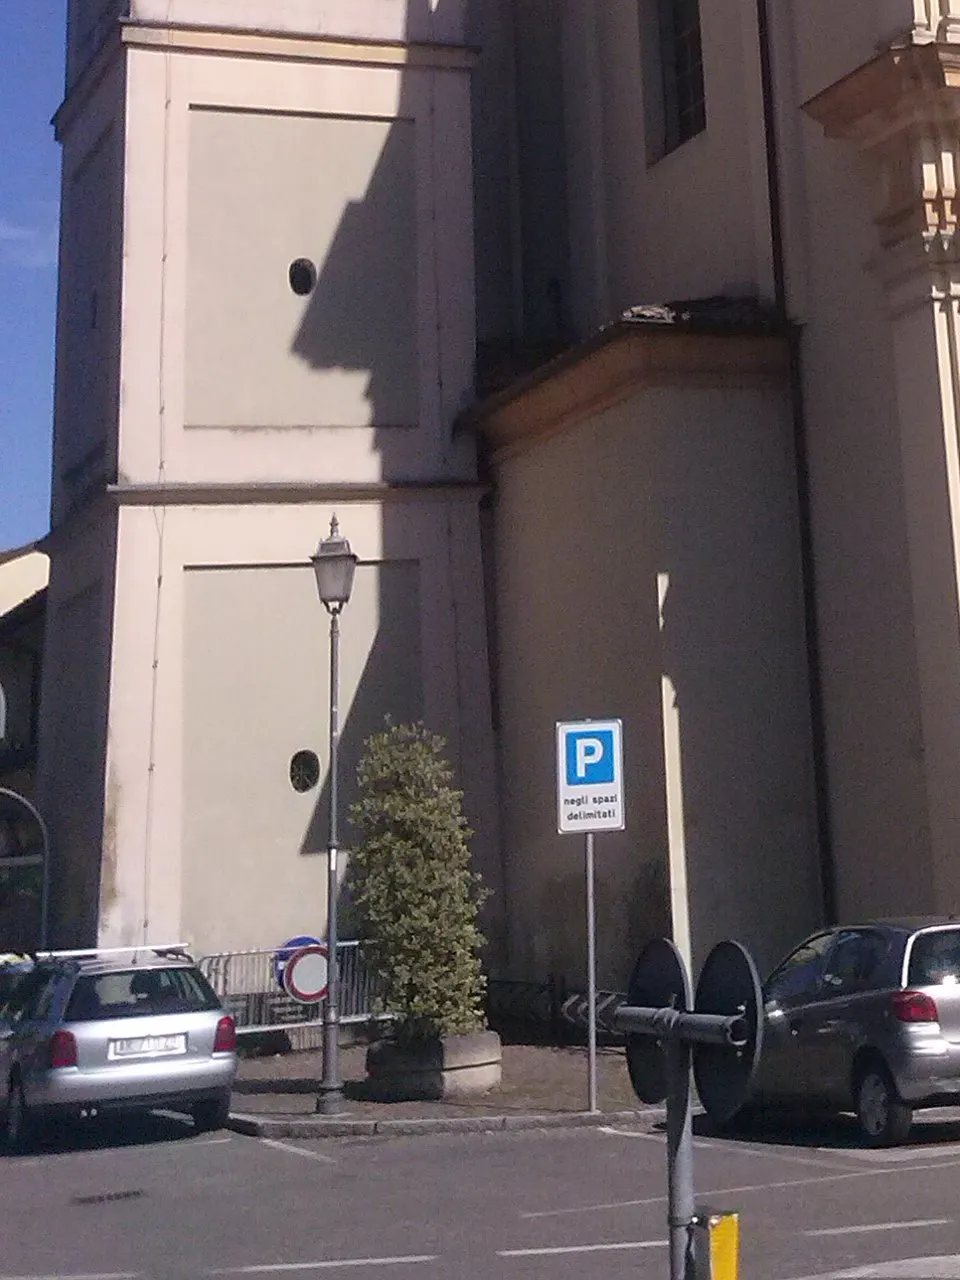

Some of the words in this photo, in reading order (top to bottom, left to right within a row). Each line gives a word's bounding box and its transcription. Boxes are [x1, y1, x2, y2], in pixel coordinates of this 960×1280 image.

[576, 738, 604, 777] P
[564, 795, 588, 807] negli
[592, 794, 618, 806] spazi
[567, 809, 615, 821] delimitati
